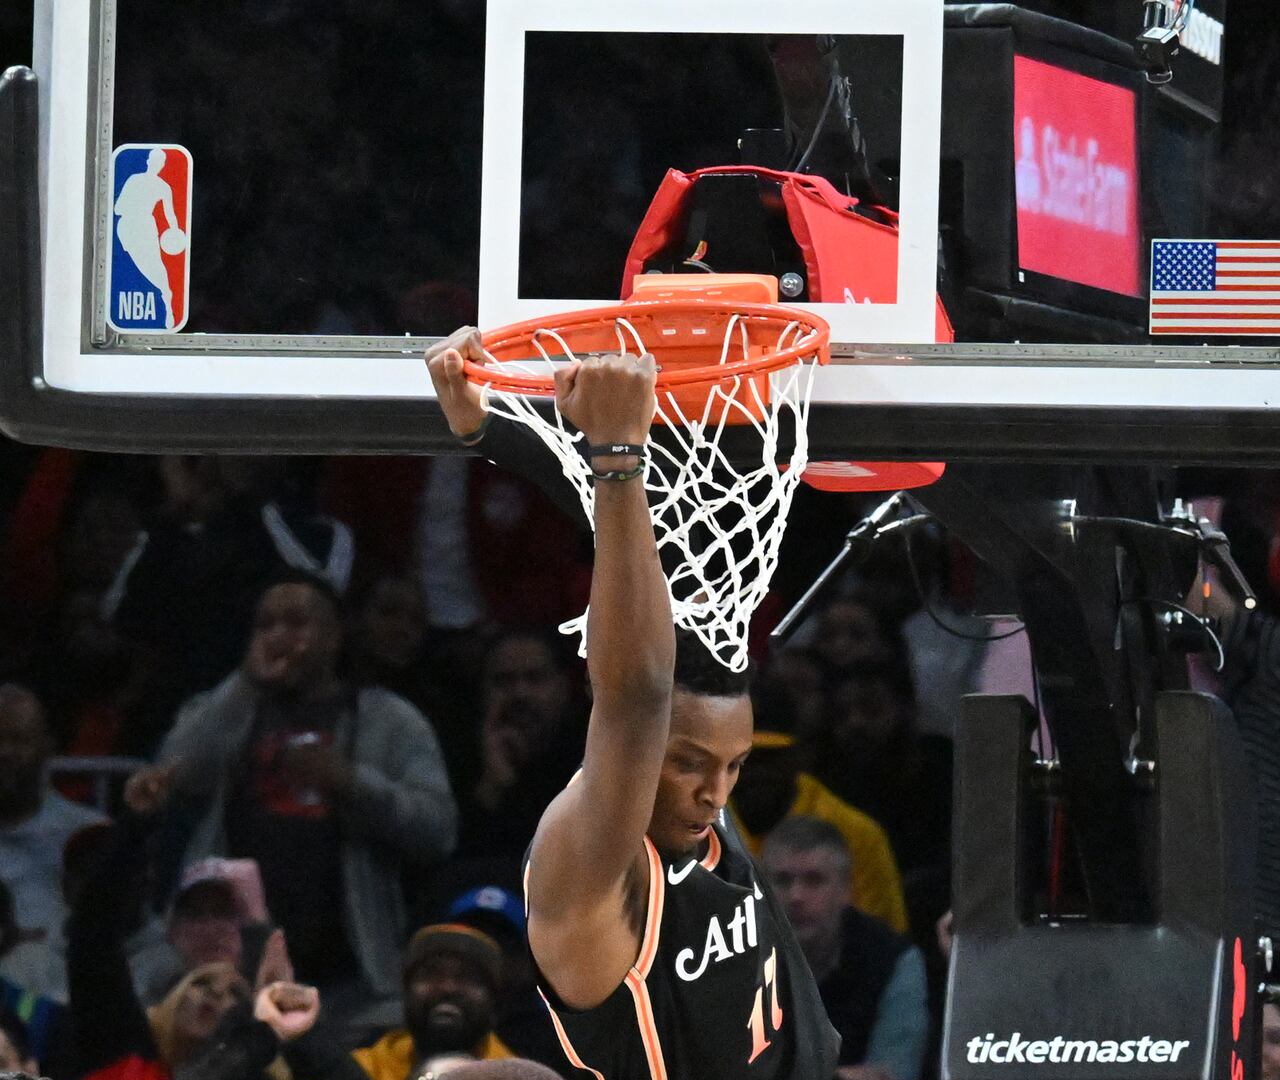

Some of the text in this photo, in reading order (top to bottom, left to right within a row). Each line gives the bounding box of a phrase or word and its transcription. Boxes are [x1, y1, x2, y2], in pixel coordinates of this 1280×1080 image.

[118, 291, 157, 321] NBA
[675, 894, 759, 982] Atl
[966, 1032, 1190, 1063] ticketmaster
